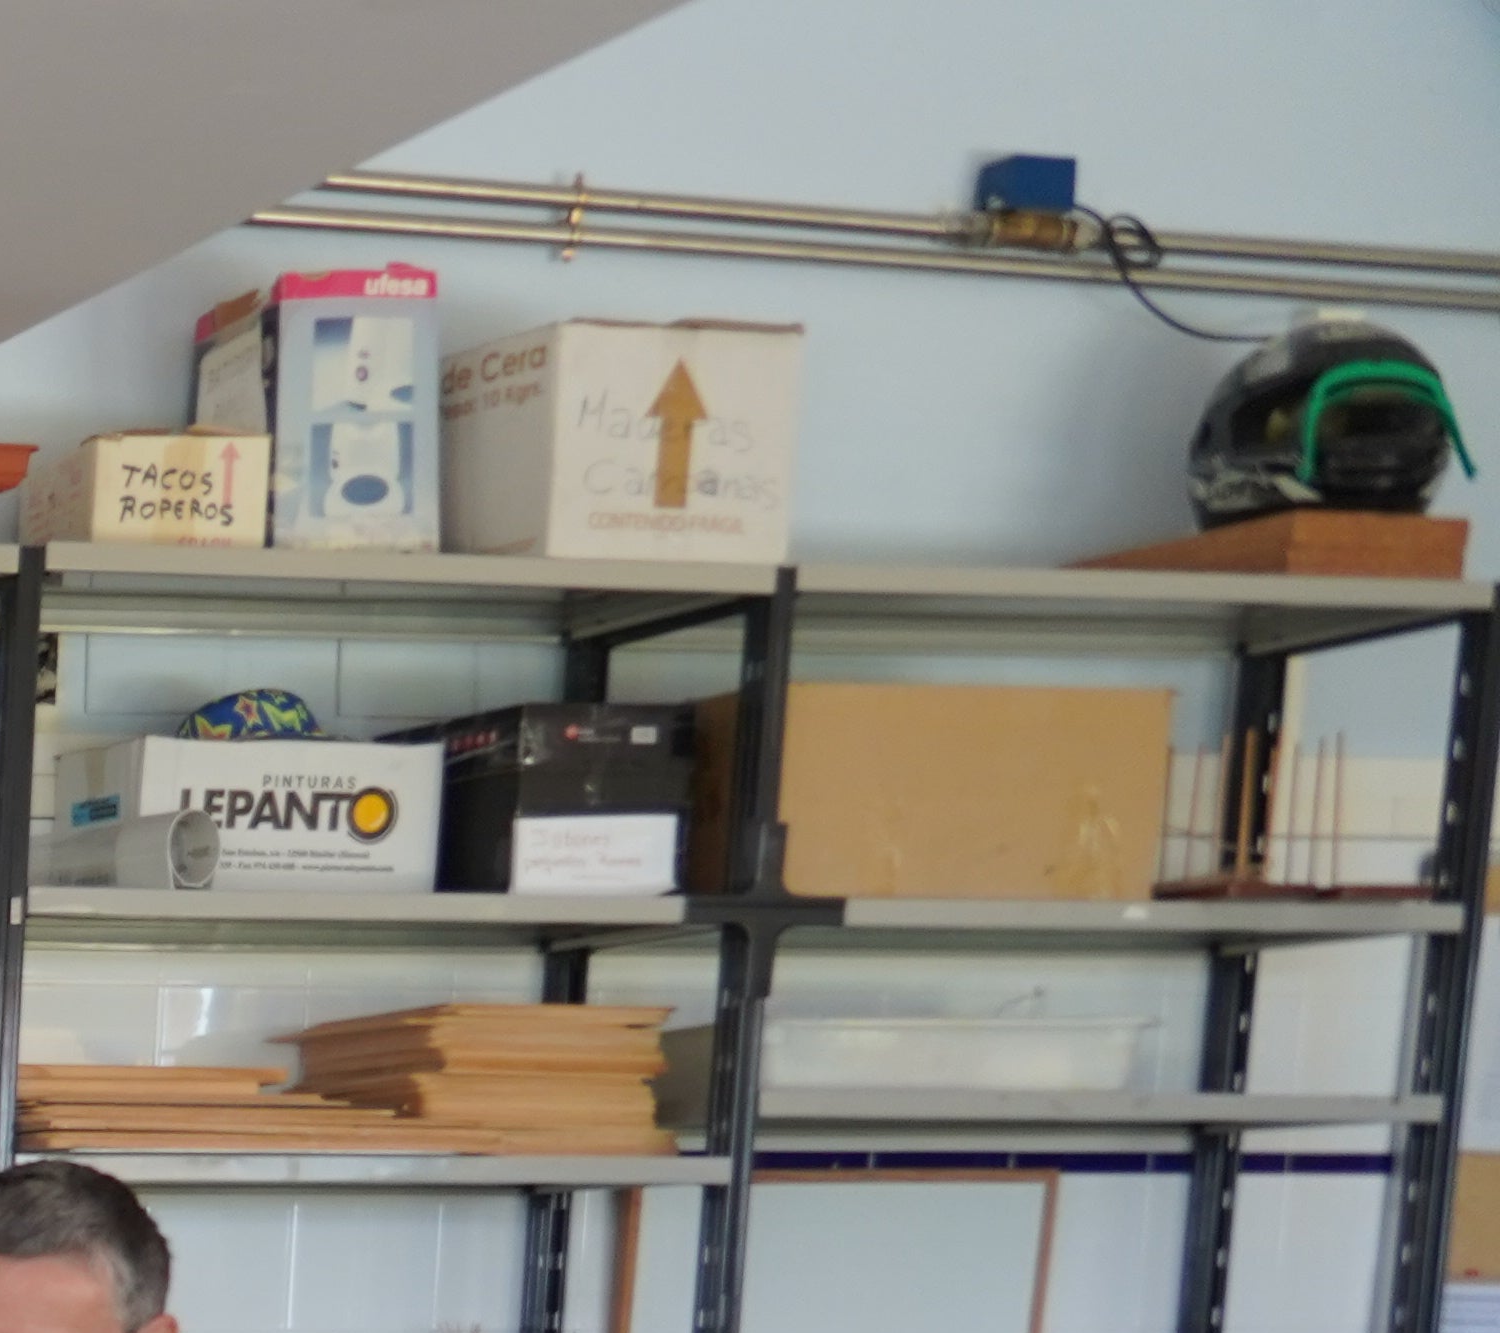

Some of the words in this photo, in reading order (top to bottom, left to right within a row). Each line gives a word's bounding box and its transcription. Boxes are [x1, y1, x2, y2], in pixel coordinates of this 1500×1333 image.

[363, 274, 429, 296] ufesa
[480, 346, 547, 382] Cera
[121, 463, 213, 494] TACOS
[119, 495, 234, 526] ROPEROS
[262, 774, 357, 789] PINTURAS
